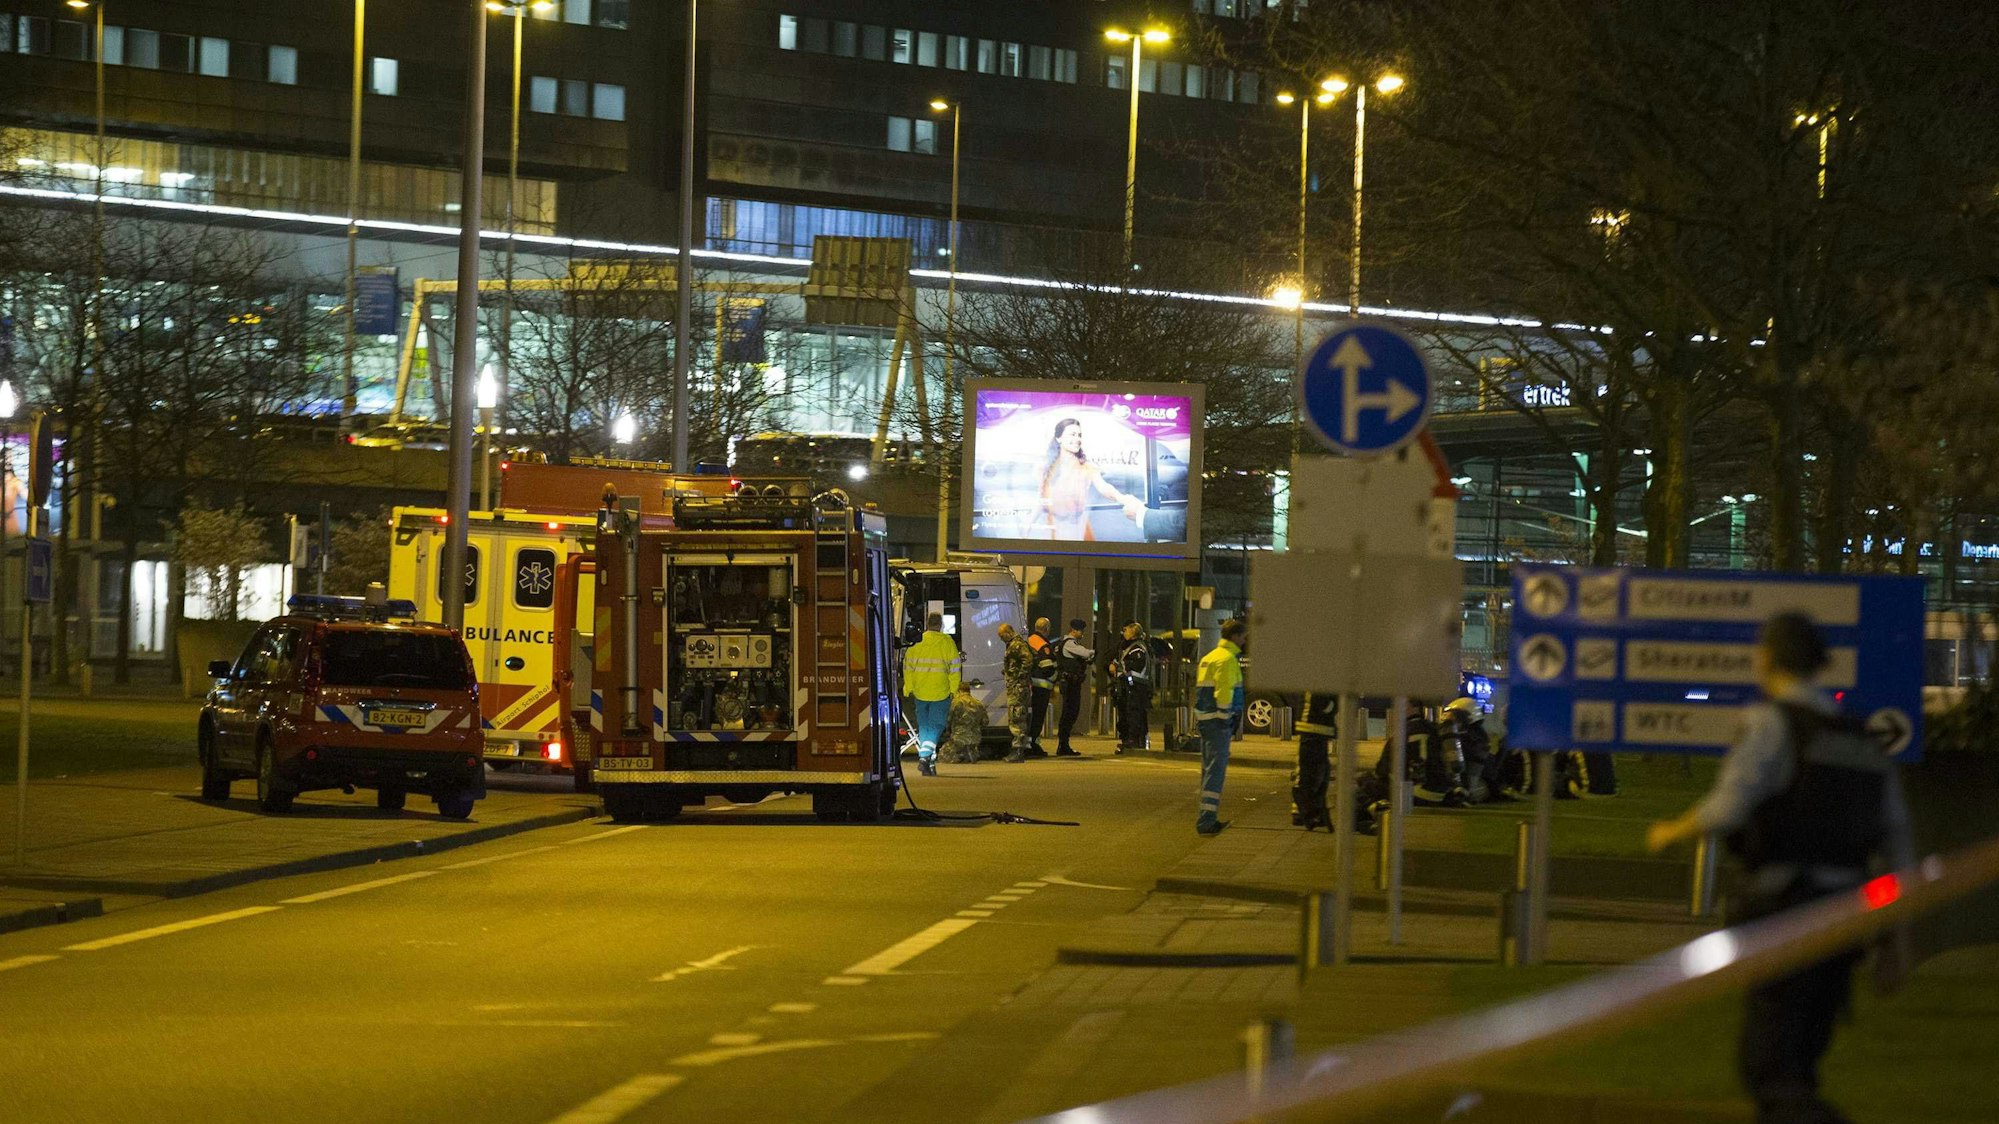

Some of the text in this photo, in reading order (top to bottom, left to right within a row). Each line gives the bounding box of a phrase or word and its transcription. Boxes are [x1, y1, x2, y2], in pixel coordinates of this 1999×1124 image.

[1136, 407, 1166, 420] QATAR
[465, 627, 555, 644] BULANCE
[1637, 711, 1692, 734] WTC
